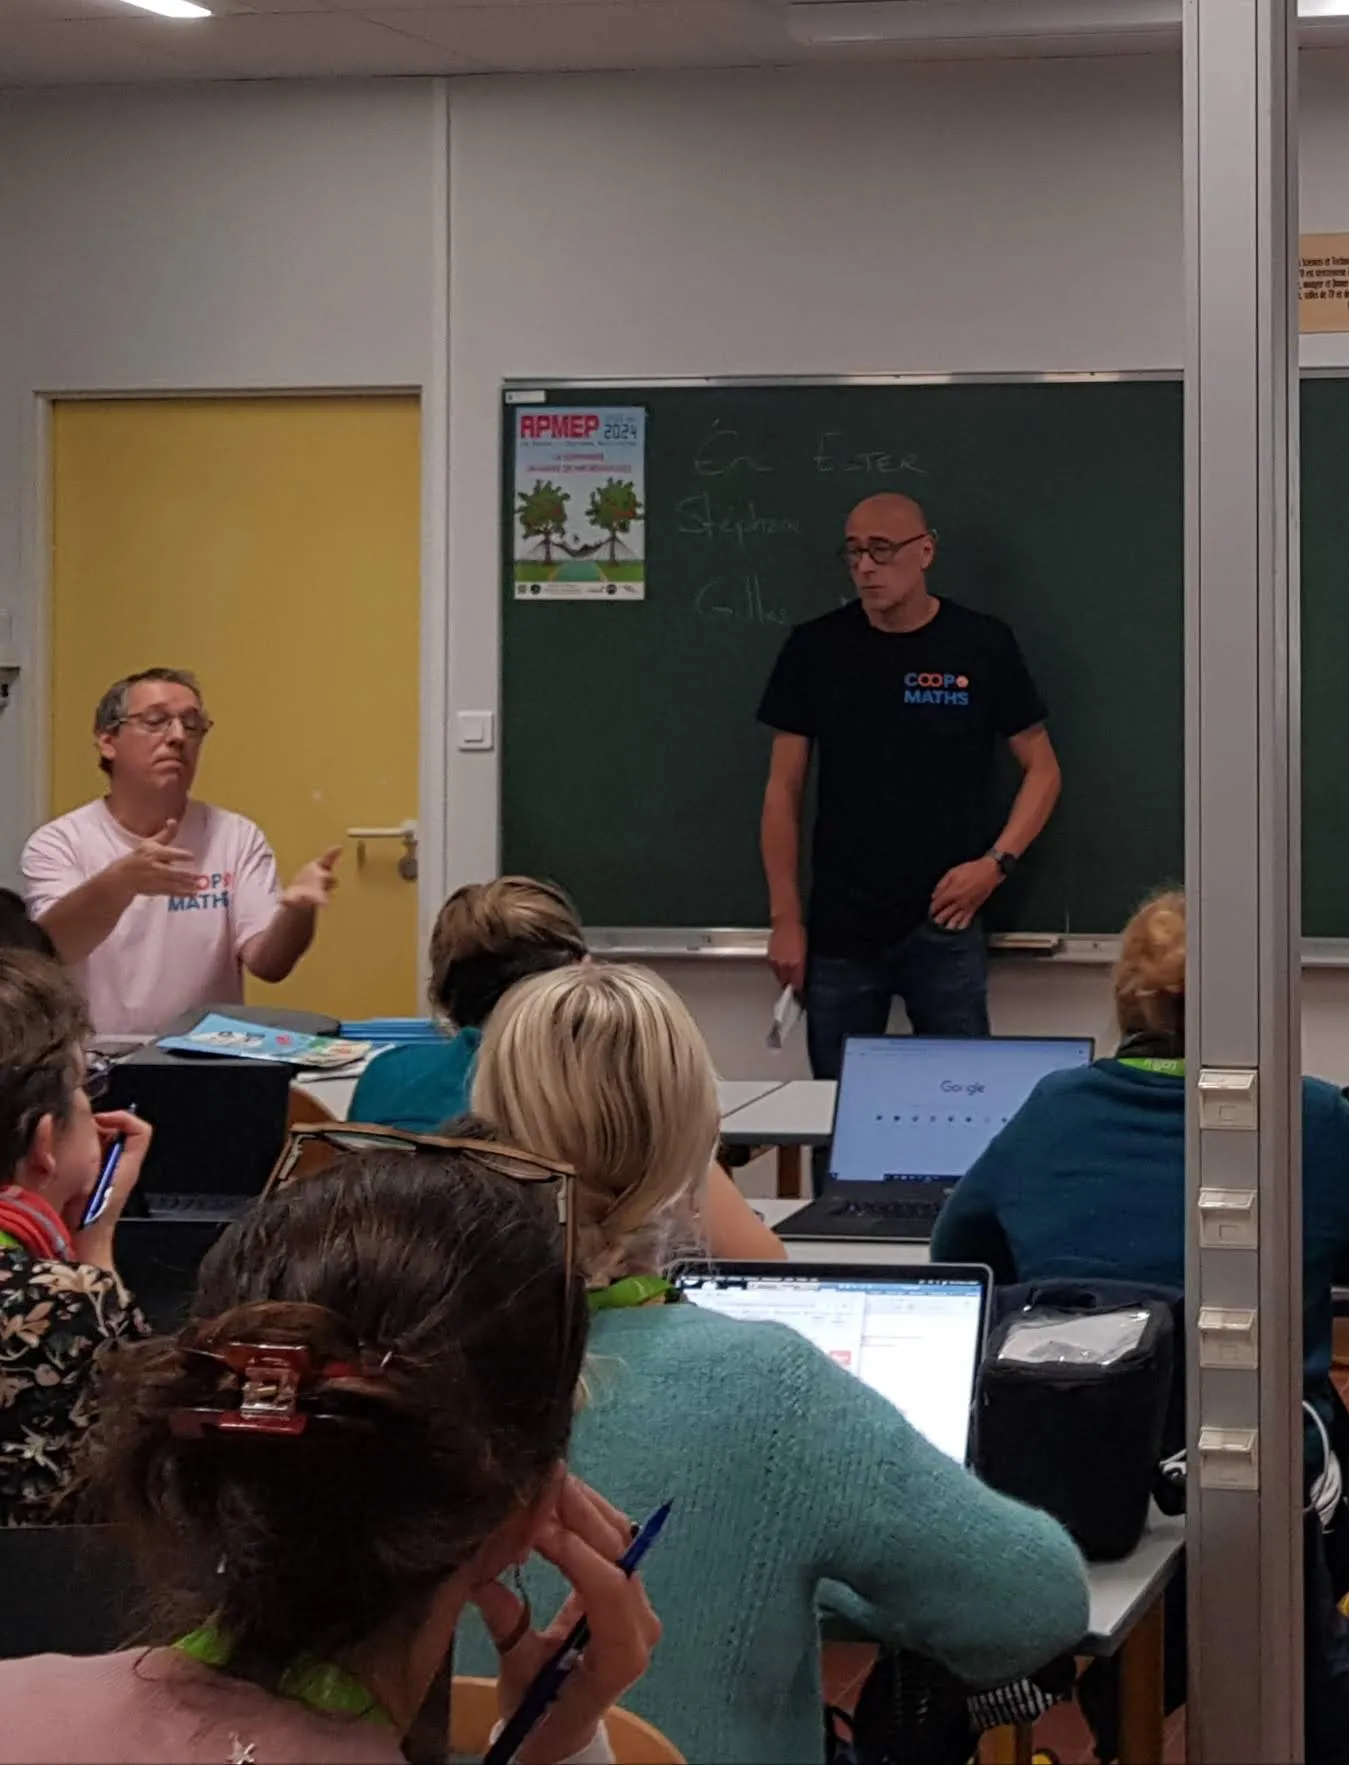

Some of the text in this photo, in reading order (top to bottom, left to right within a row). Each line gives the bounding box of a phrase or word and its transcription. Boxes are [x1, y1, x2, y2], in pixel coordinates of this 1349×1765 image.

[520, 415, 600, 439] APMEP
[603, 423, 637, 439] 2024
[904, 689, 969, 706] MATHS
[940, 1080, 986, 1096] Google
